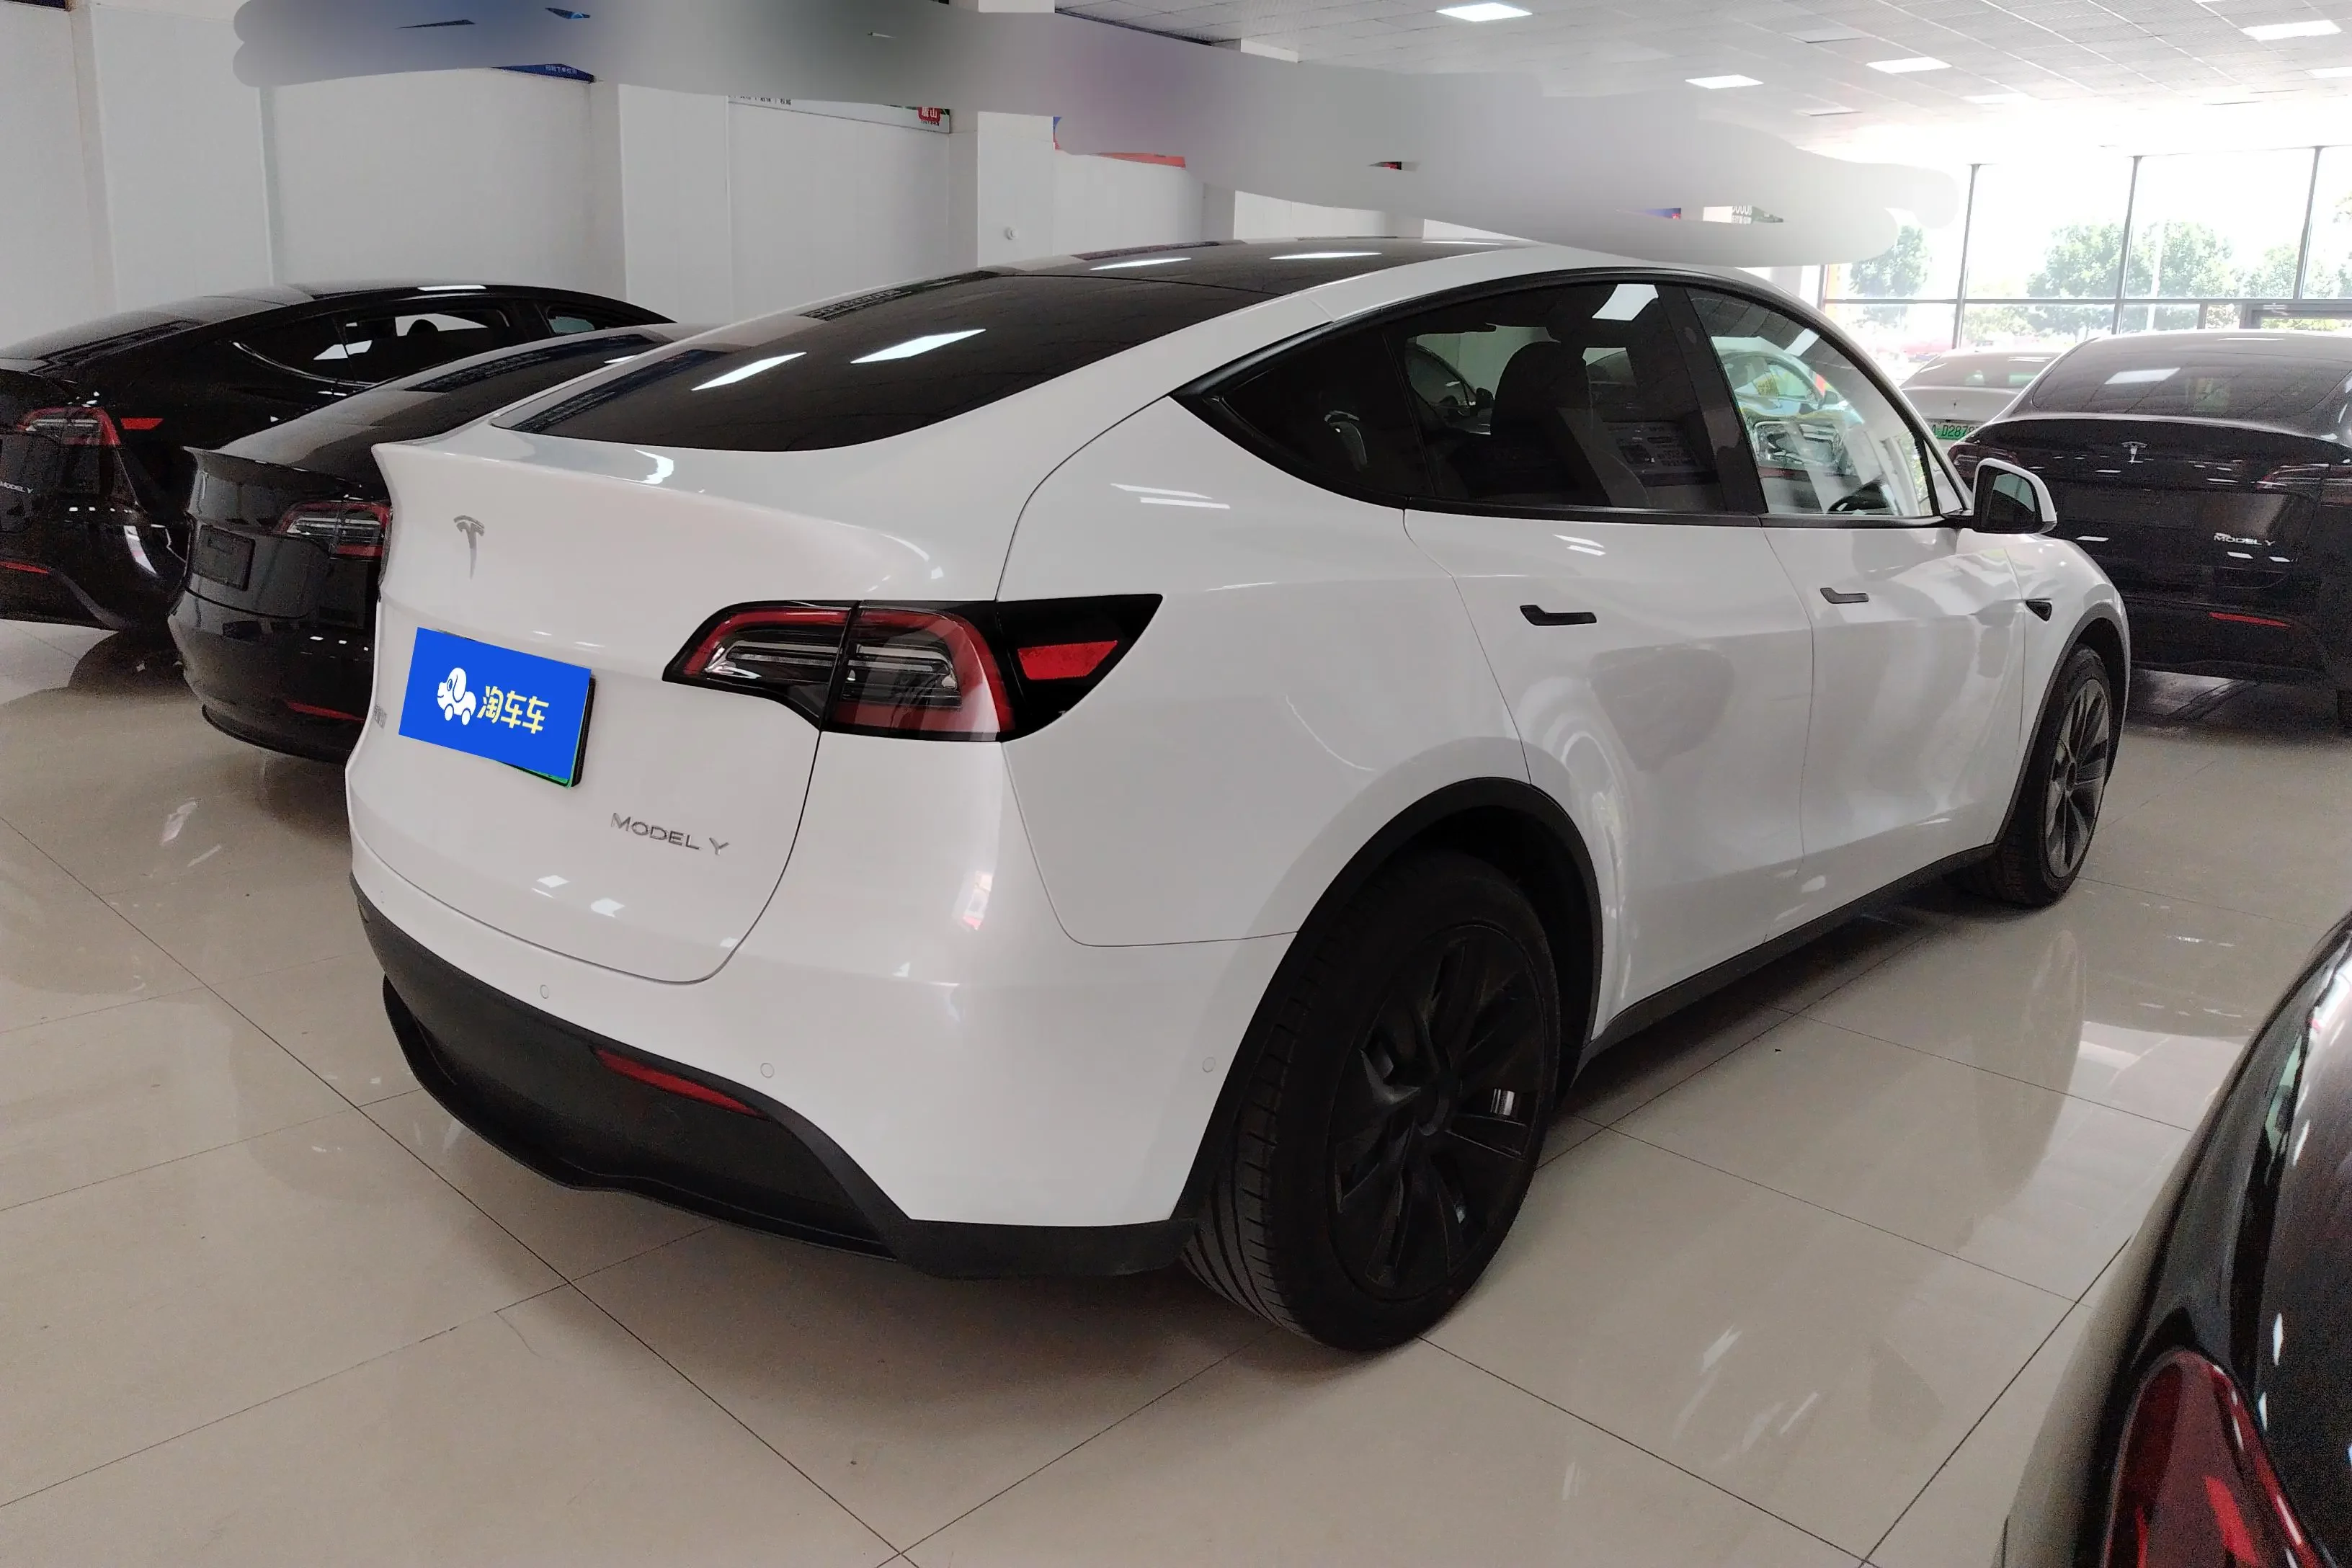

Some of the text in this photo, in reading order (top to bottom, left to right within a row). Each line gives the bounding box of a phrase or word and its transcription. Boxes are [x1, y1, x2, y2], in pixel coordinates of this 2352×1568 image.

[2214, 534, 2262, 545] MODEL
[611, 812, 729, 856] MODEL Y
